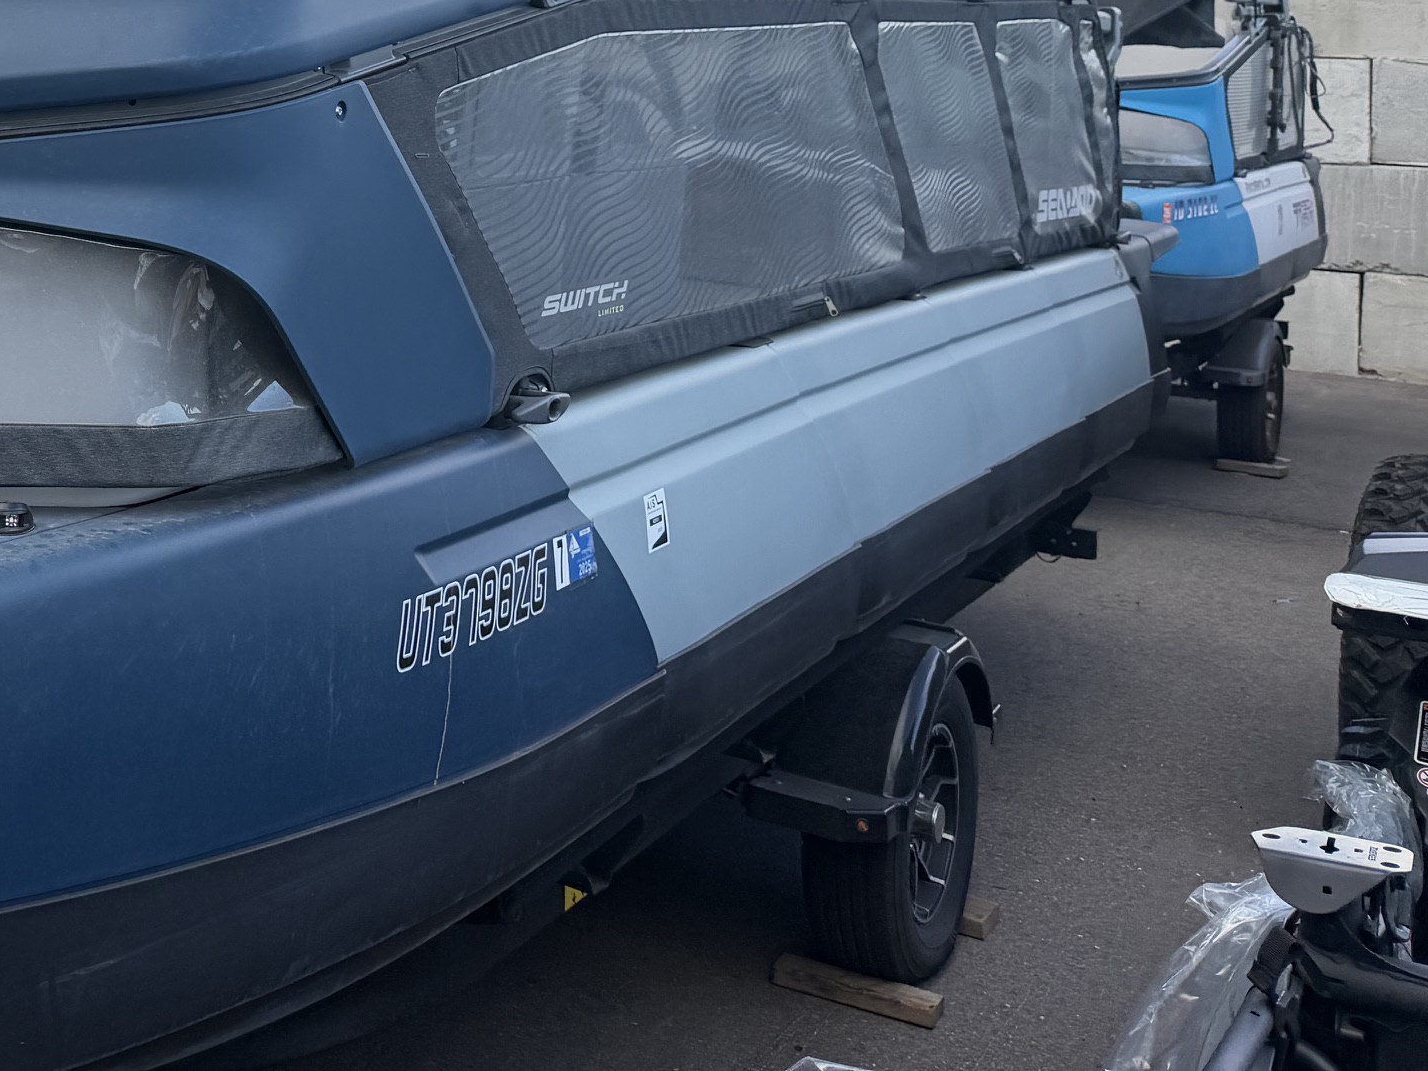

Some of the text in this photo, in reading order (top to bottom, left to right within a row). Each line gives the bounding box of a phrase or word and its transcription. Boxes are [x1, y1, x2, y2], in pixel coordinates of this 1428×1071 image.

[540, 279, 629, 317] SWITCH
[597, 304, 624, 317] LIMITED
[396, 542, 548, 673] UT3798ZG
